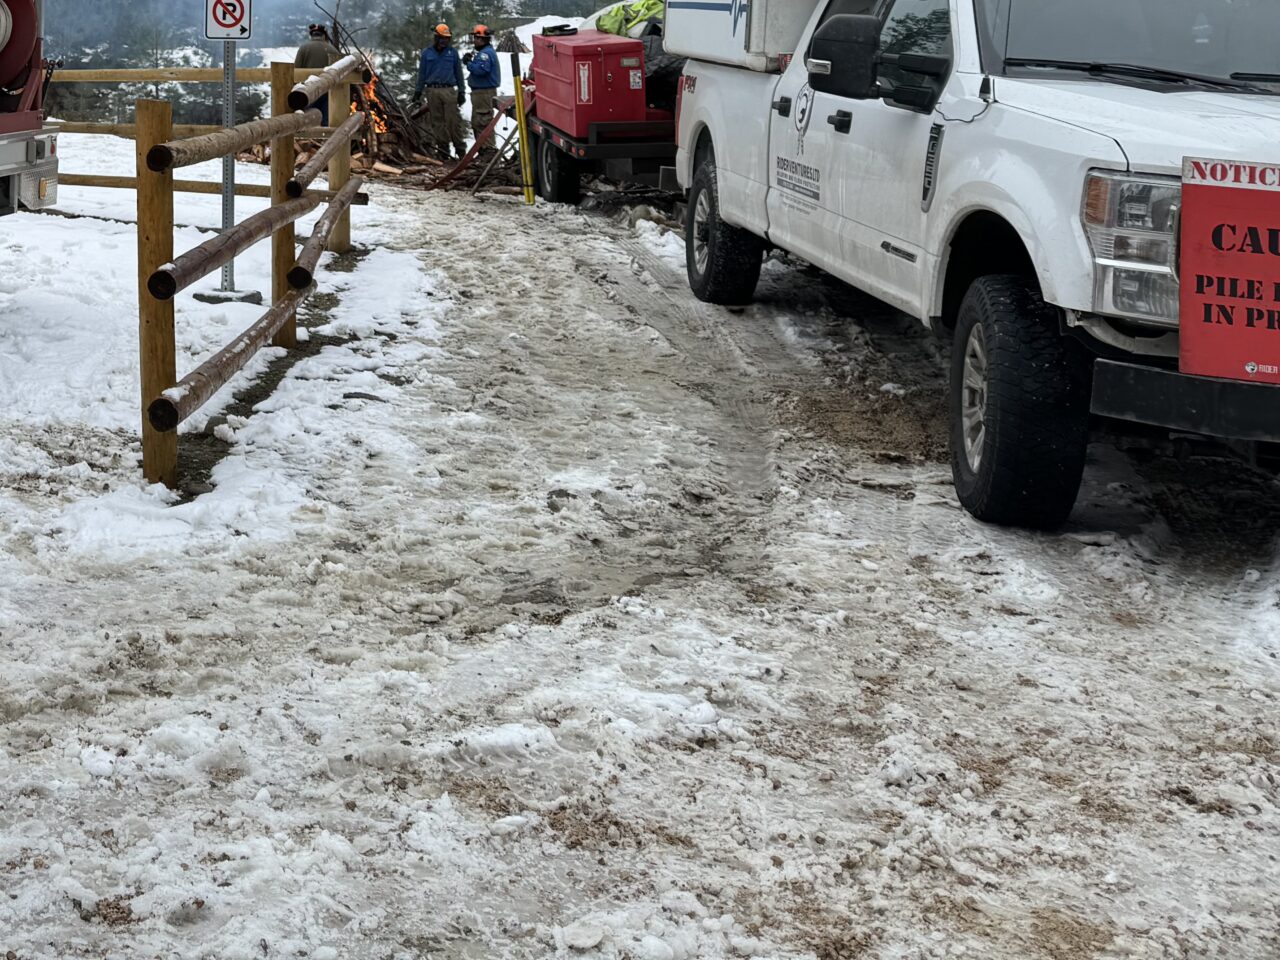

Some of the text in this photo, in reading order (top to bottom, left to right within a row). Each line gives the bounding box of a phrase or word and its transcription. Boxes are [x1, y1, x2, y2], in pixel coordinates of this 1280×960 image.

[1191, 160, 1280, 186] NOTIC
[1195, 274, 1263, 300] PILE
[1202, 303, 1235, 325] IN
